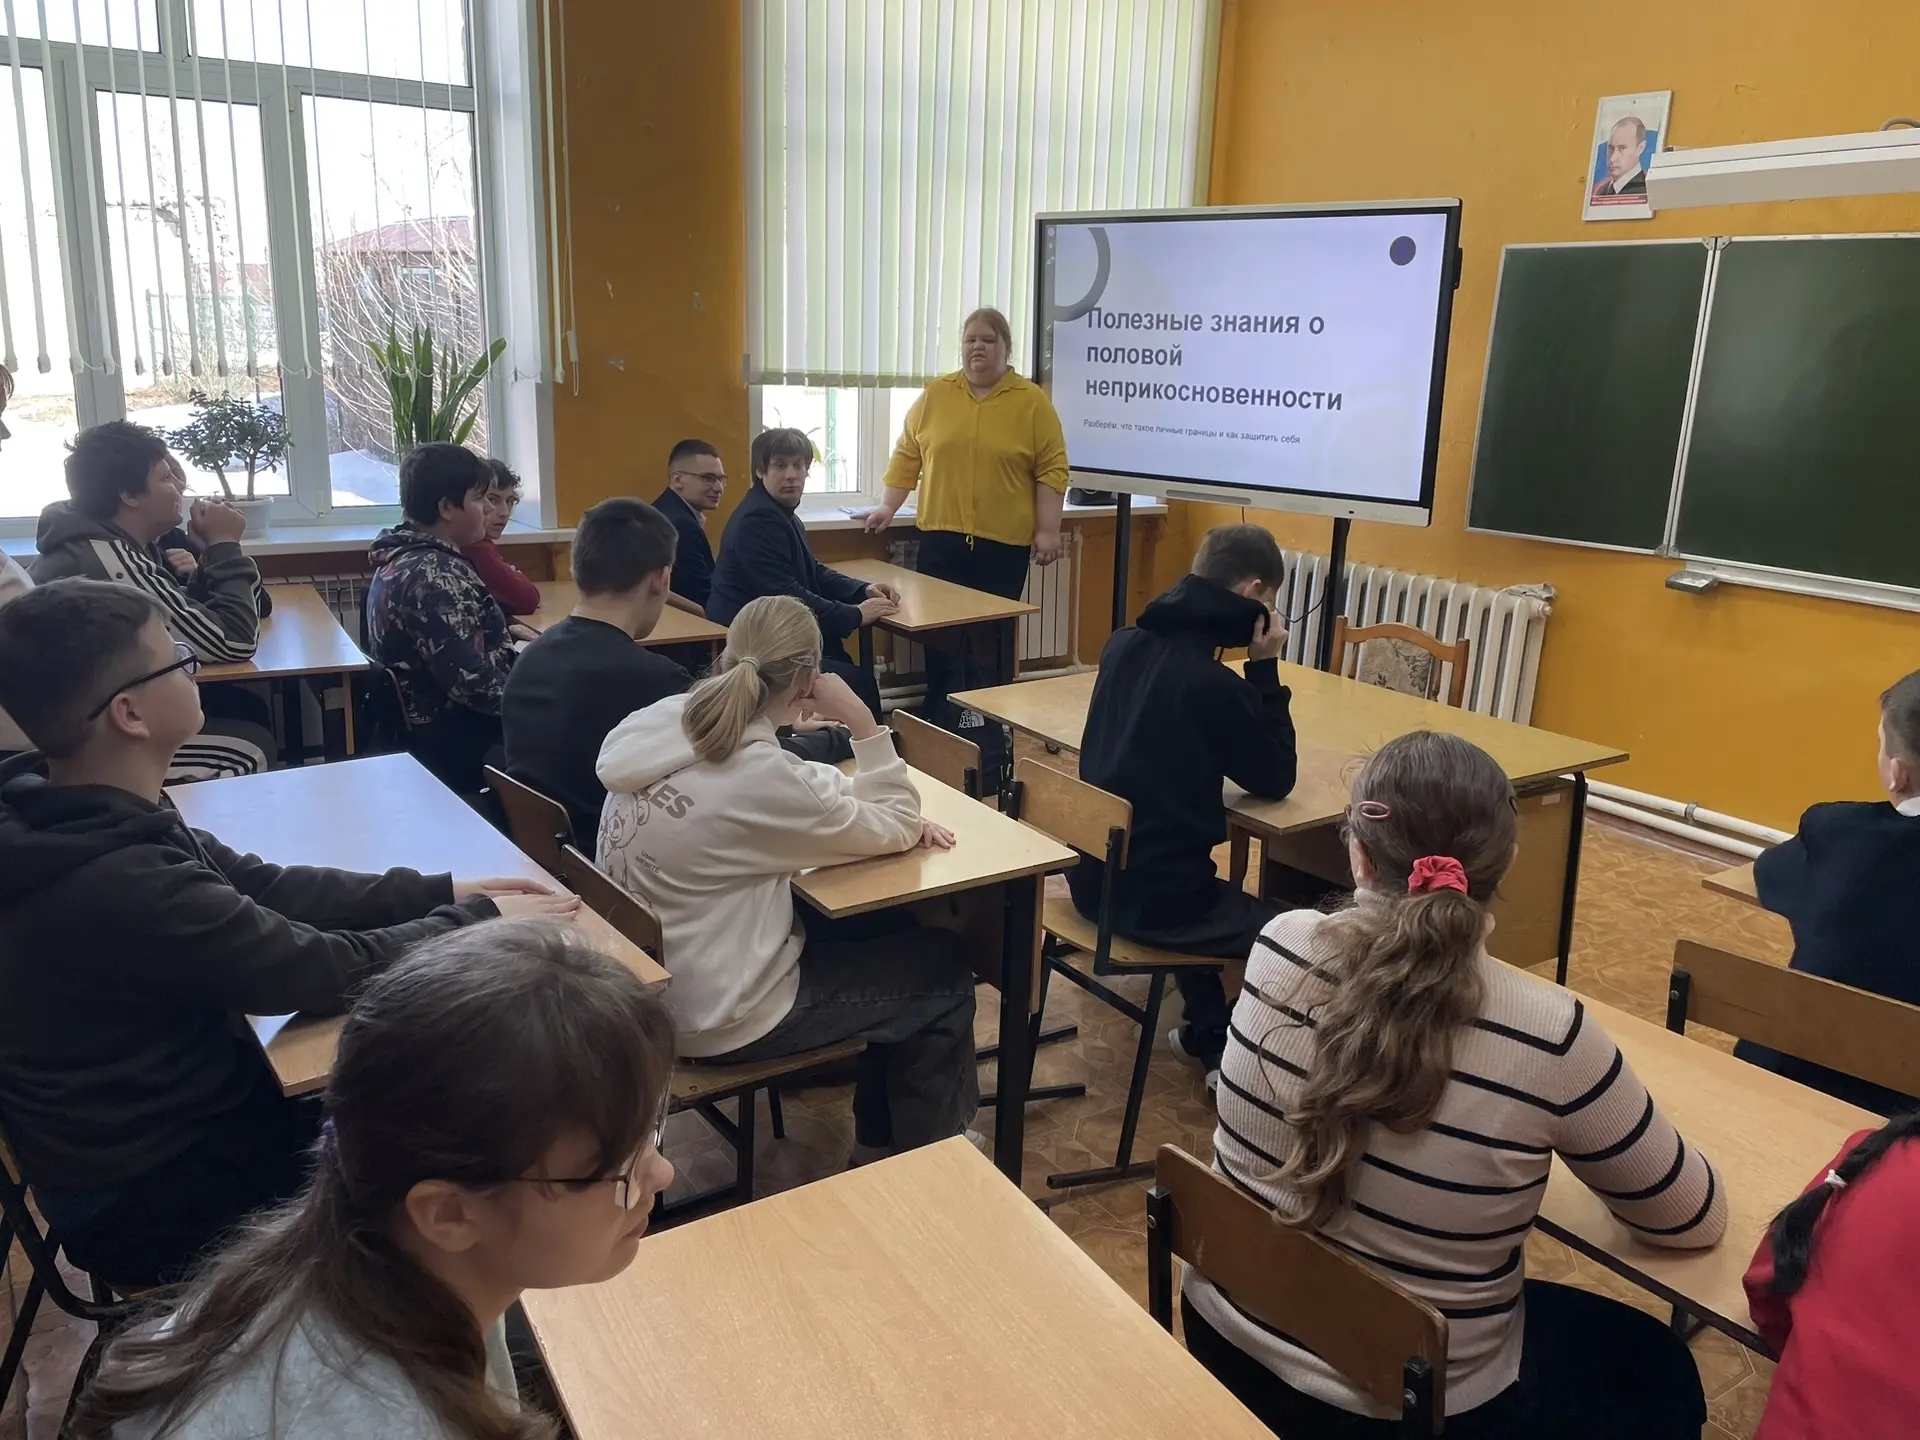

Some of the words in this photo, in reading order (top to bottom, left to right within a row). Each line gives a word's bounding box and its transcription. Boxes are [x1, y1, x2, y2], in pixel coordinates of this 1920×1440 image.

[1087, 307, 1203, 332] Полезные
[1210, 314, 1300, 334] знания
[1309, 316, 1325, 335] о
[1087, 343, 1182, 366] половой
[1086, 379, 1343, 411] неприкосновенности
[1120, 423, 1133, 431] что
[1134, 424, 1154, 433] такое
[1155, 426, 1183, 435] личные
[1185, 428, 1218, 438] границы
[1226, 431, 1239, 440] как
[1240, 432, 1279, 442] защитить
[1280, 434, 1301, 444] себя
